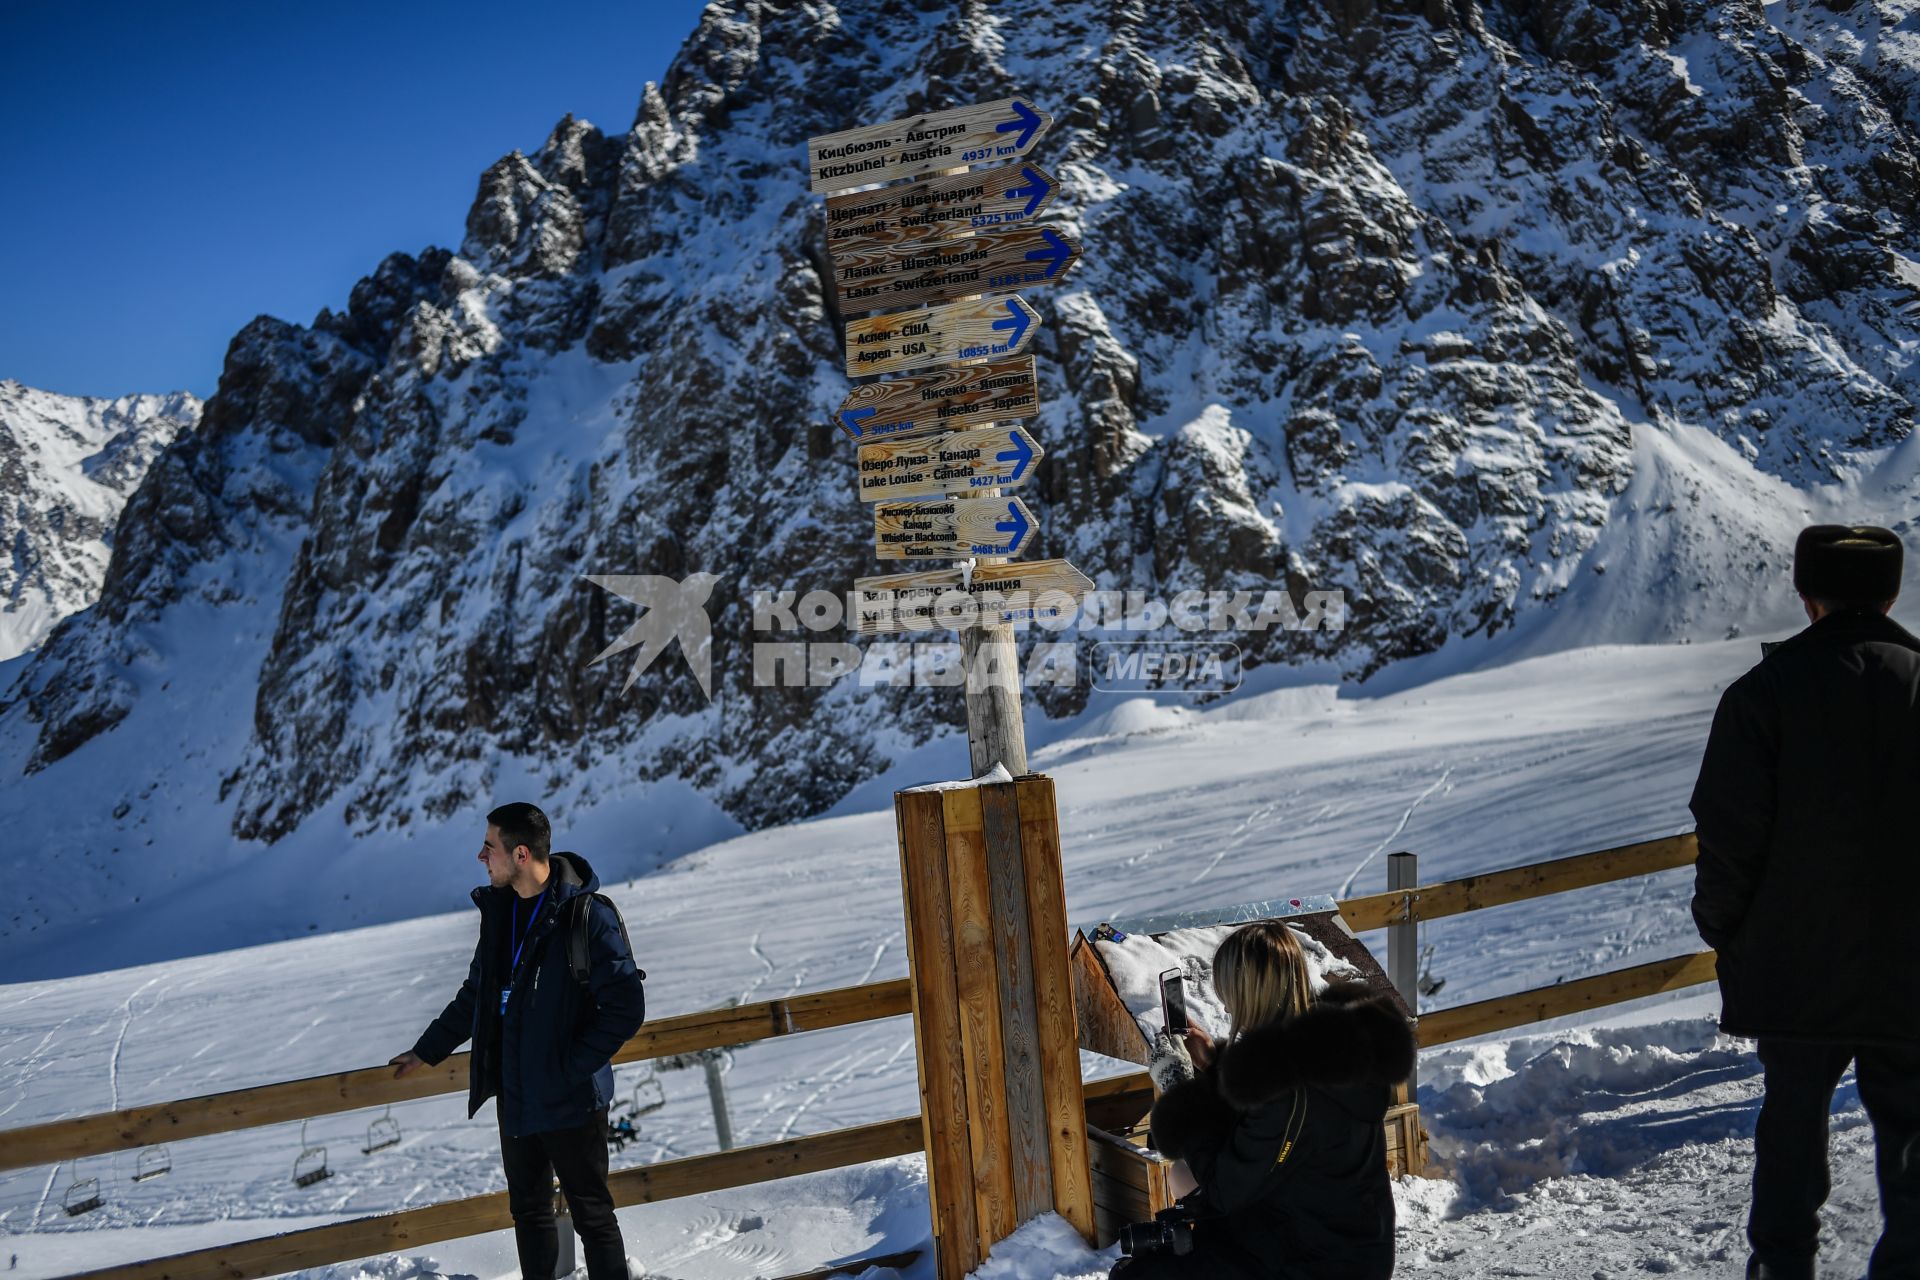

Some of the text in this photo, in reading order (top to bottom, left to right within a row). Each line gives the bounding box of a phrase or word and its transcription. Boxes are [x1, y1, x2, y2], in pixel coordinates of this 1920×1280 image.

[818, 139, 892, 161] Кицбюэль
[906, 124, 966, 144] Австрия
[819, 156, 886, 179] Kitzbuhel
[900, 145, 952, 164] Austria
[961, 145, 1016, 162] 4937 km
[831, 203, 888, 222] Церматт
[901, 185, 984, 209] Швейцария
[833, 220, 887, 239] Zermatt
[900, 203, 982, 229] Switzerland
[971, 210, 1024, 228] 5325 km
[843, 266, 887, 280] Лаакс
[901, 250, 988, 271] Швейцария
[846, 284, 880, 299] Laax
[893, 269, 980, 292] Switzerland
[857, 328, 891, 345] Аспен
[902, 322, 930, 337] США
[857, 348, 891, 363] Aspen
[902, 342, 927, 356] USA
[958, 342, 1008, 359] 10855 km
[922, 384, 967, 401] Нисеко
[979, 373, 1029, 391] Япония
[937, 403, 980, 418] Niseko
[992, 394, 1031, 413] Japan
[898, 421, 914, 431] km
[862, 459, 895, 472] Озеро
[895, 455, 928, 470] Луиза
[939, 449, 981, 462] Канада
[862, 476, 887, 488] Lake
[889, 472, 923, 486] Louise
[934, 466, 974, 480] Canada
[970, 474, 1012, 487] 9427 km
[903, 520, 932, 530] Канада
[881, 532, 957, 543] Whistler Blackcomb
[905, 546, 933, 556] Canada
[971, 544, 1009, 555] 9468 km
[863, 608, 885, 621] Val
[1038, 607, 1057, 618] km
